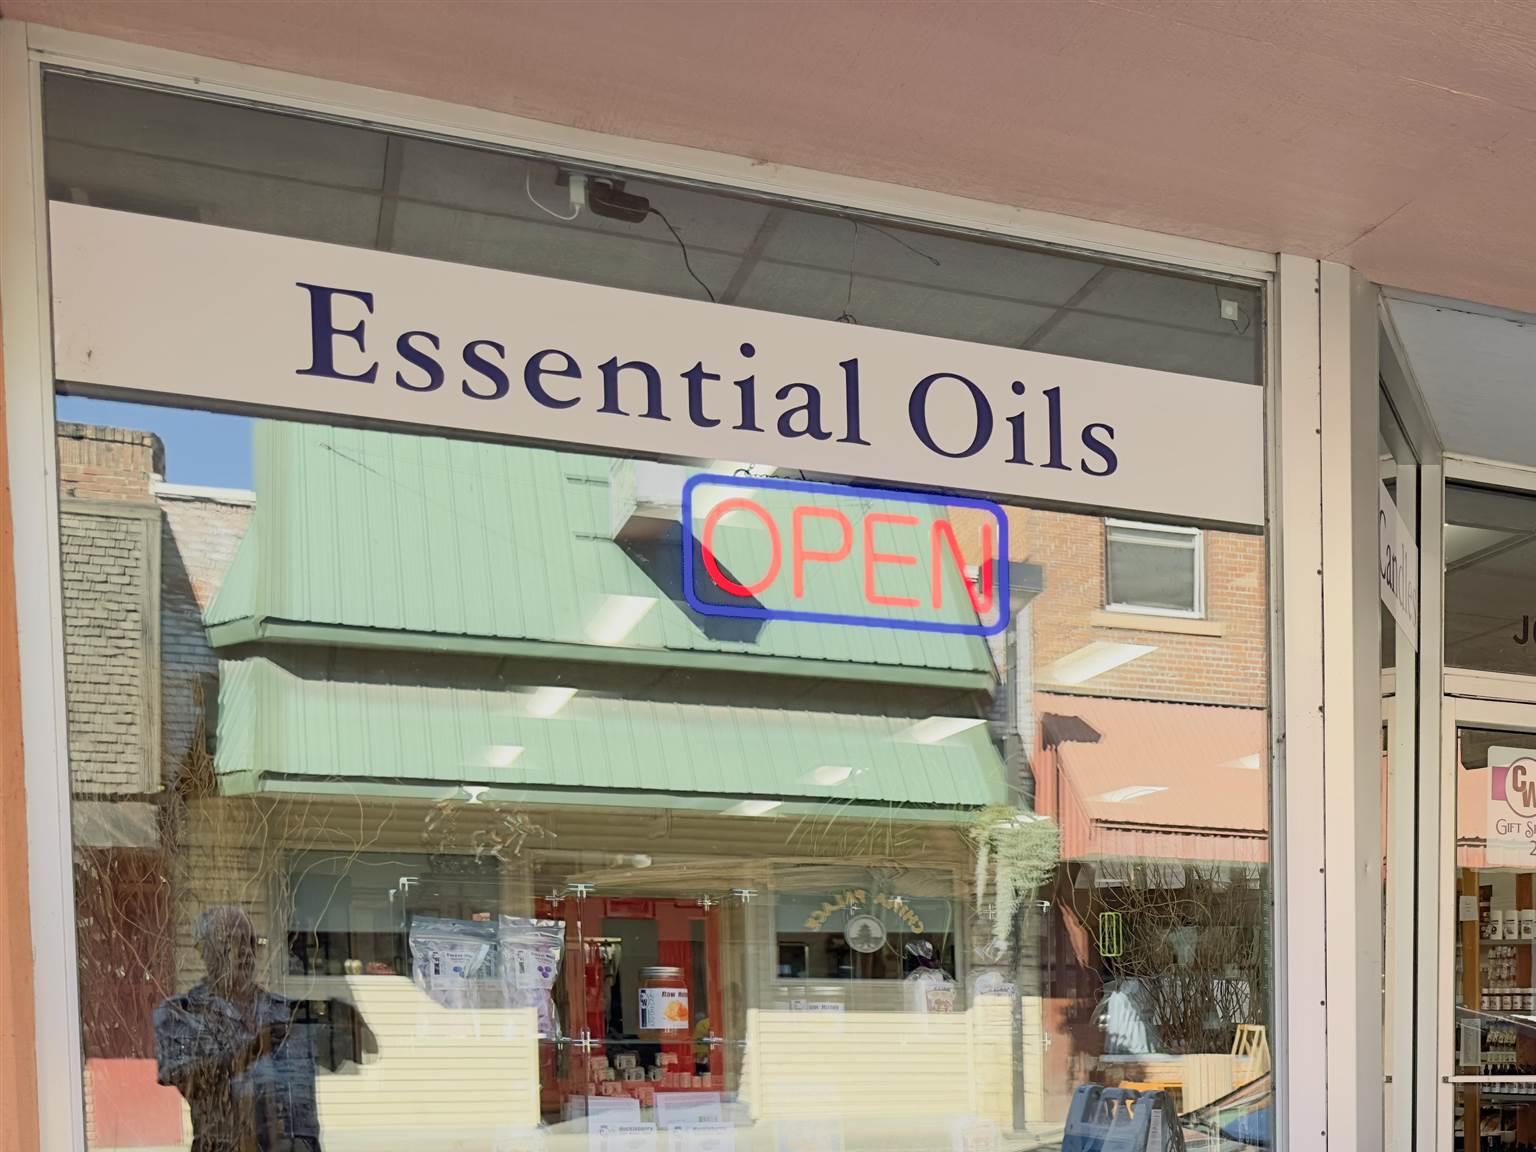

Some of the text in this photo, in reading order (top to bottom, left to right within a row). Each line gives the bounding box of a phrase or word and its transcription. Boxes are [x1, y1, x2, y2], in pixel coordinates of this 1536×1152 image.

[295, 281, 1119, 477] Essential Oils
[700, 497, 994, 616] OPEN
